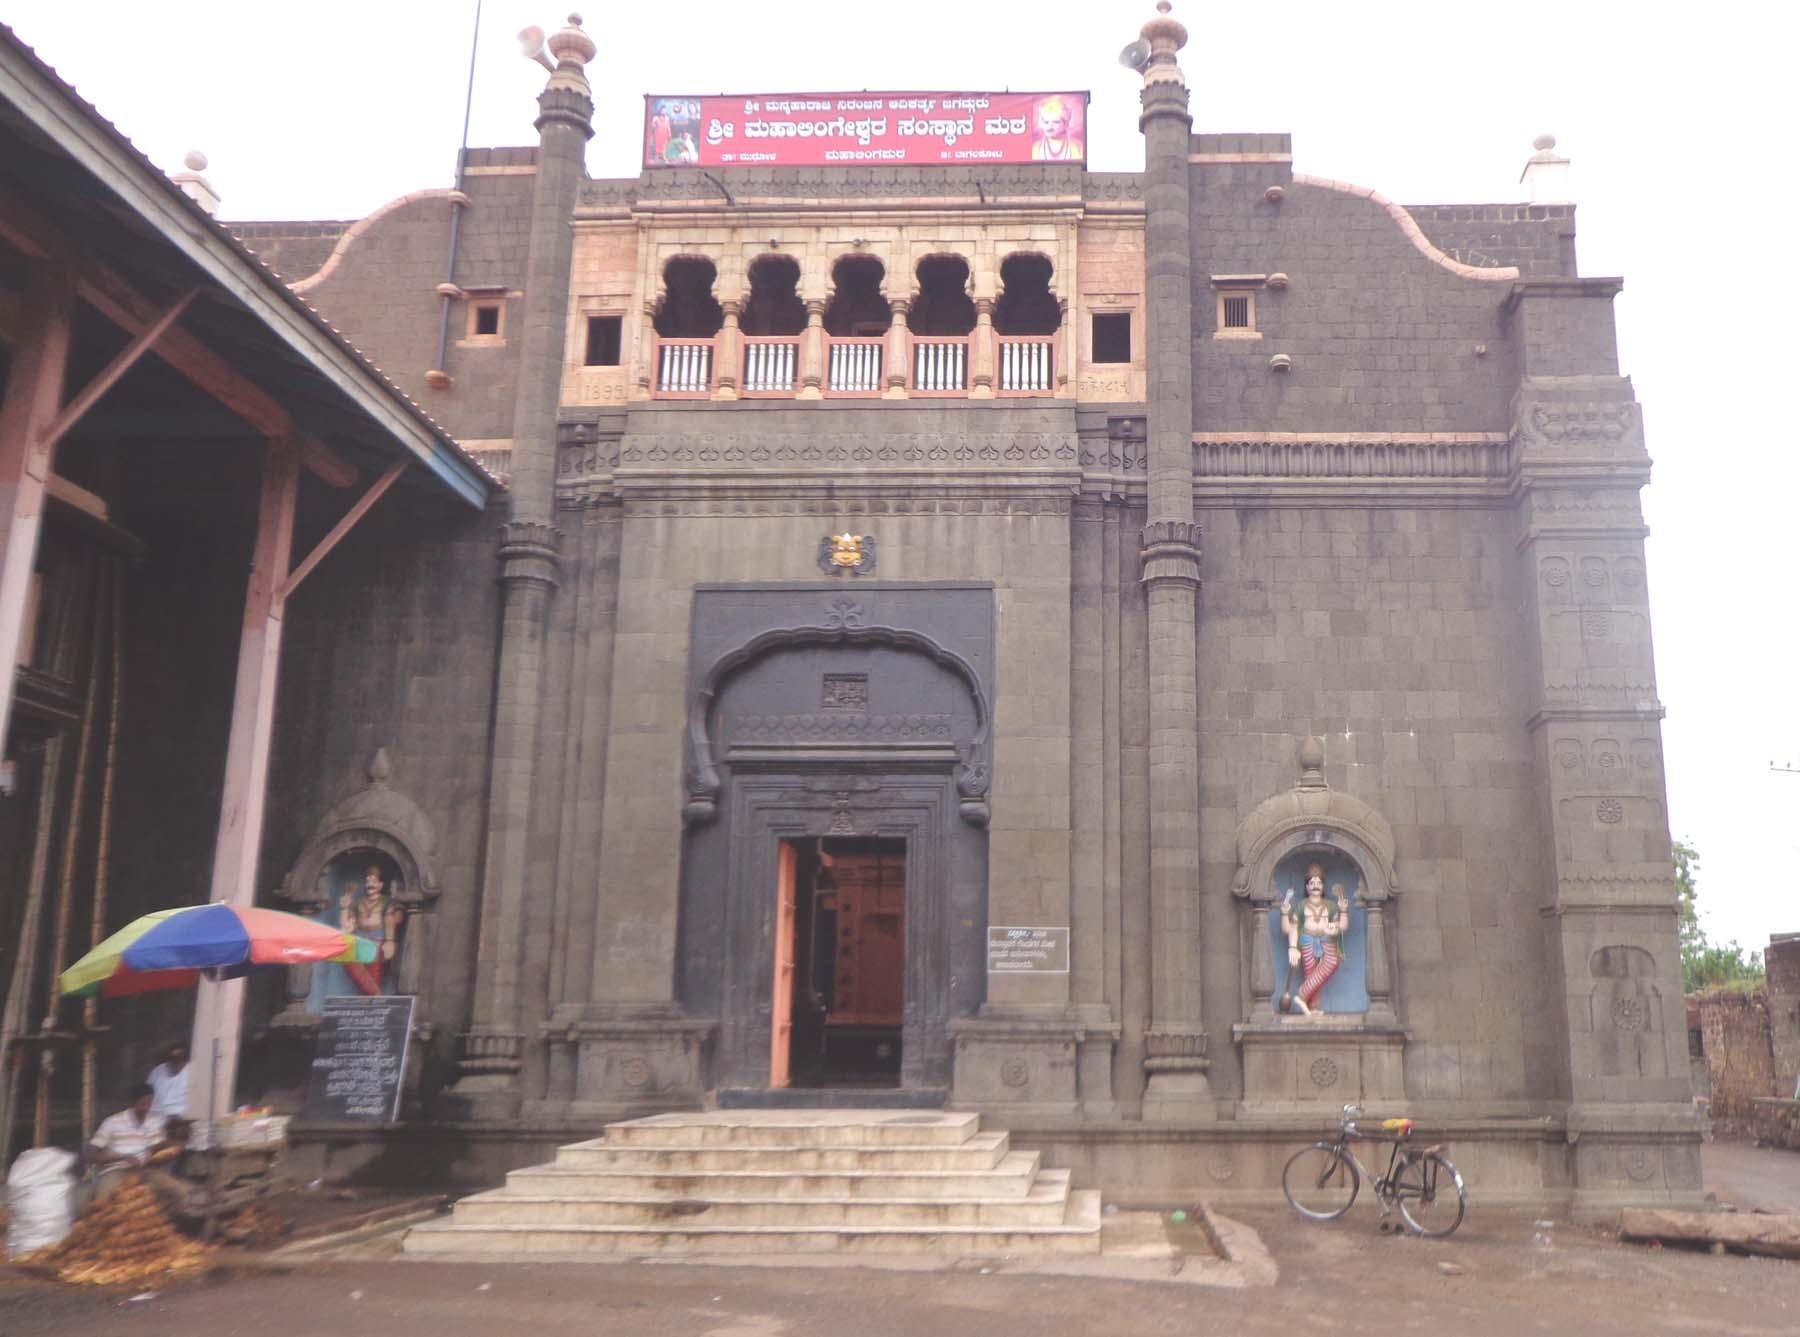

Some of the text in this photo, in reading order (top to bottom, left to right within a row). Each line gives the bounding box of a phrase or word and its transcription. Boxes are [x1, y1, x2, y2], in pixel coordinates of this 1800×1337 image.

[744, 99, 760, 115] ಶ್ರೀ
[706, 115, 1027, 147] ಶ್ರೀ ಮಹಾಲಿಂಗೇಶ್ವರ ಸಂಸ್ಥಾನ ಮಠ
[825, 149, 905, 160] ಮಹಾಲಿಂಗಪುರ
